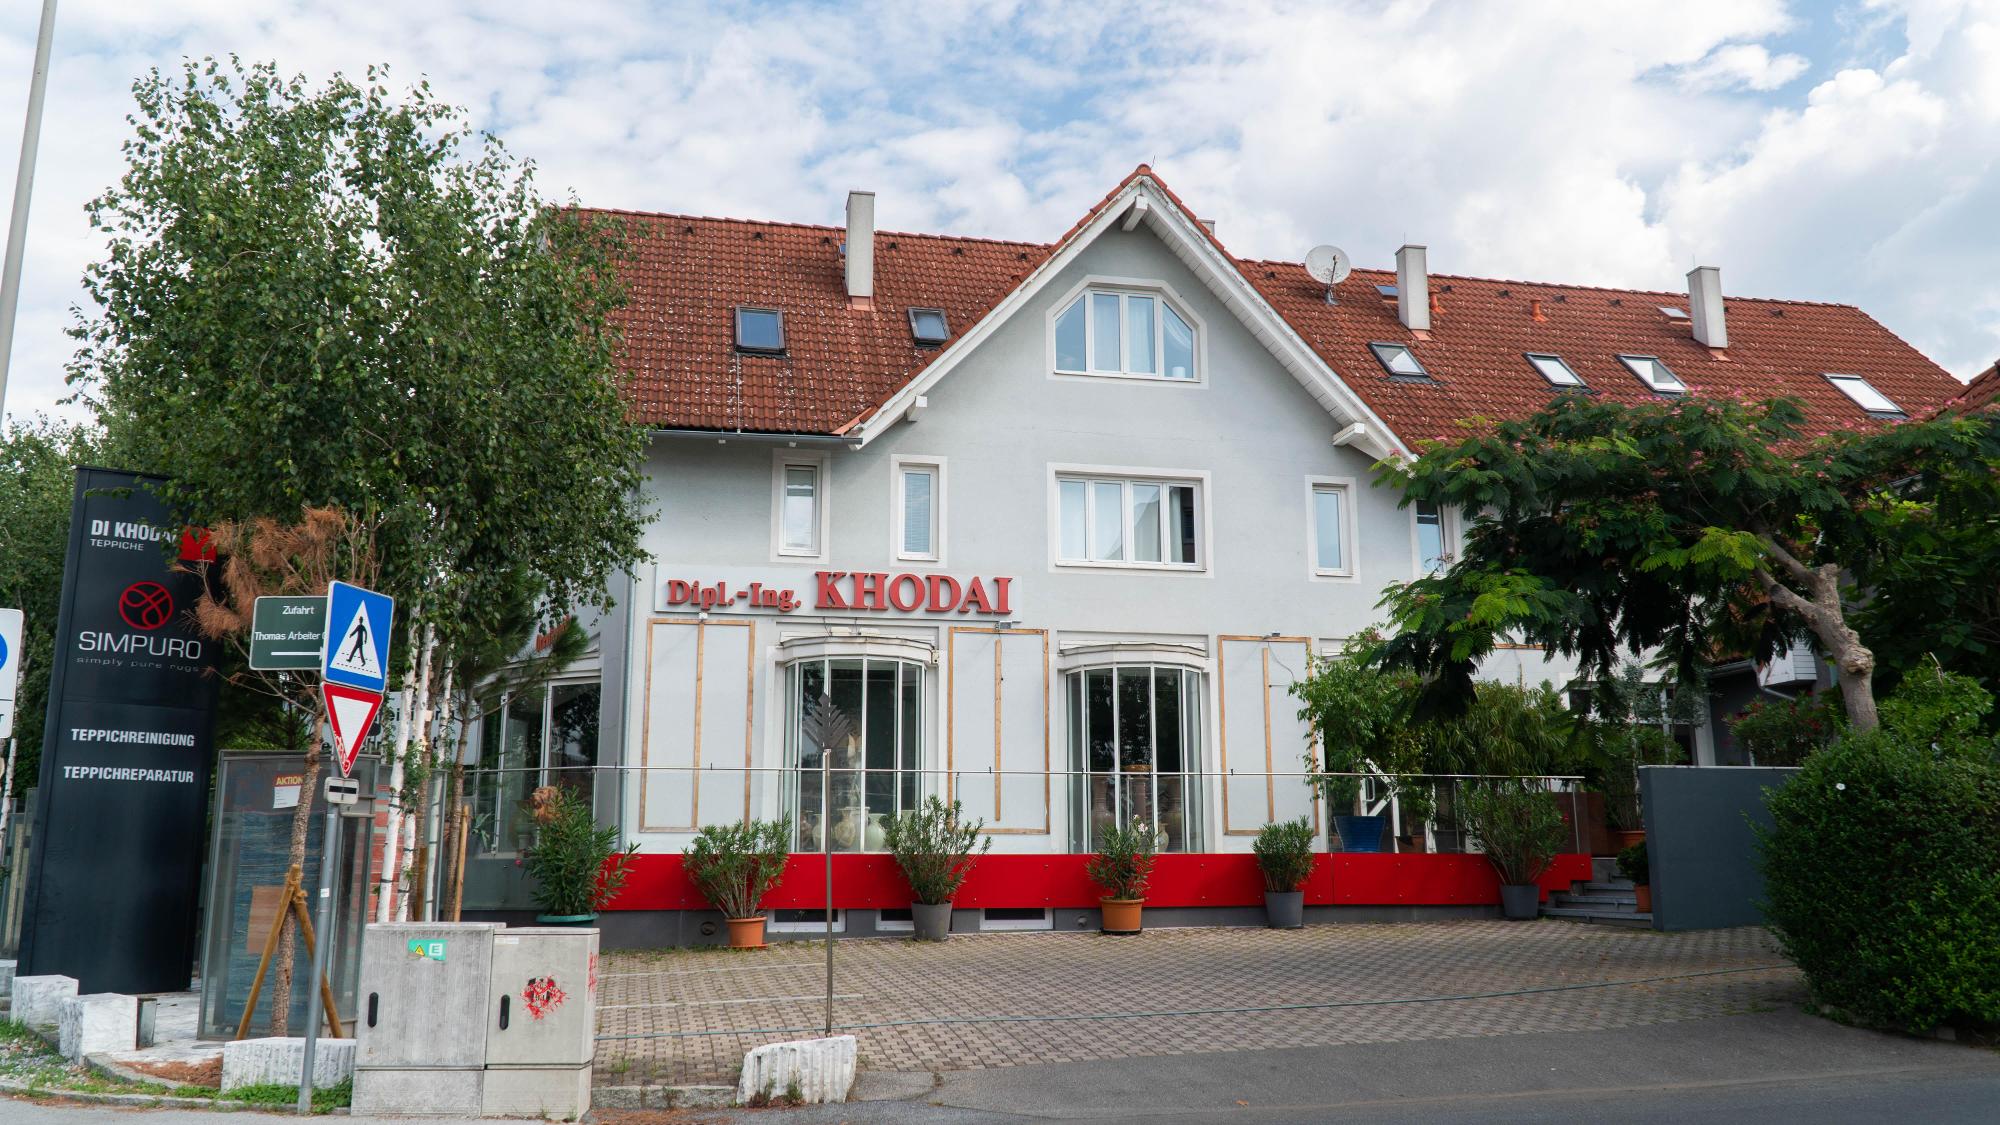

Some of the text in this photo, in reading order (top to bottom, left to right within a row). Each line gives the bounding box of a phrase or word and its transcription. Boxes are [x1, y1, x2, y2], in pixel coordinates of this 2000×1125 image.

[91, 519, 110, 537] DI
[90, 538, 144, 551] TEPPICHE
[667, 570, 1013, 615] Dipl.-Ing. KHODAI
[282, 605, 315, 615] Zufahrt
[254, 631, 286, 640] Thomas
[287, 631, 320, 640] Arbeiter
[78, 631, 201, 660] SIMPURO
[76, 657, 123, 666] simply
[169, 664, 199, 672] rugs
[71, 728, 195, 747] TEPPICHREINIGUNG
[63, 766, 194, 783] TEPPICHREPARATUR
